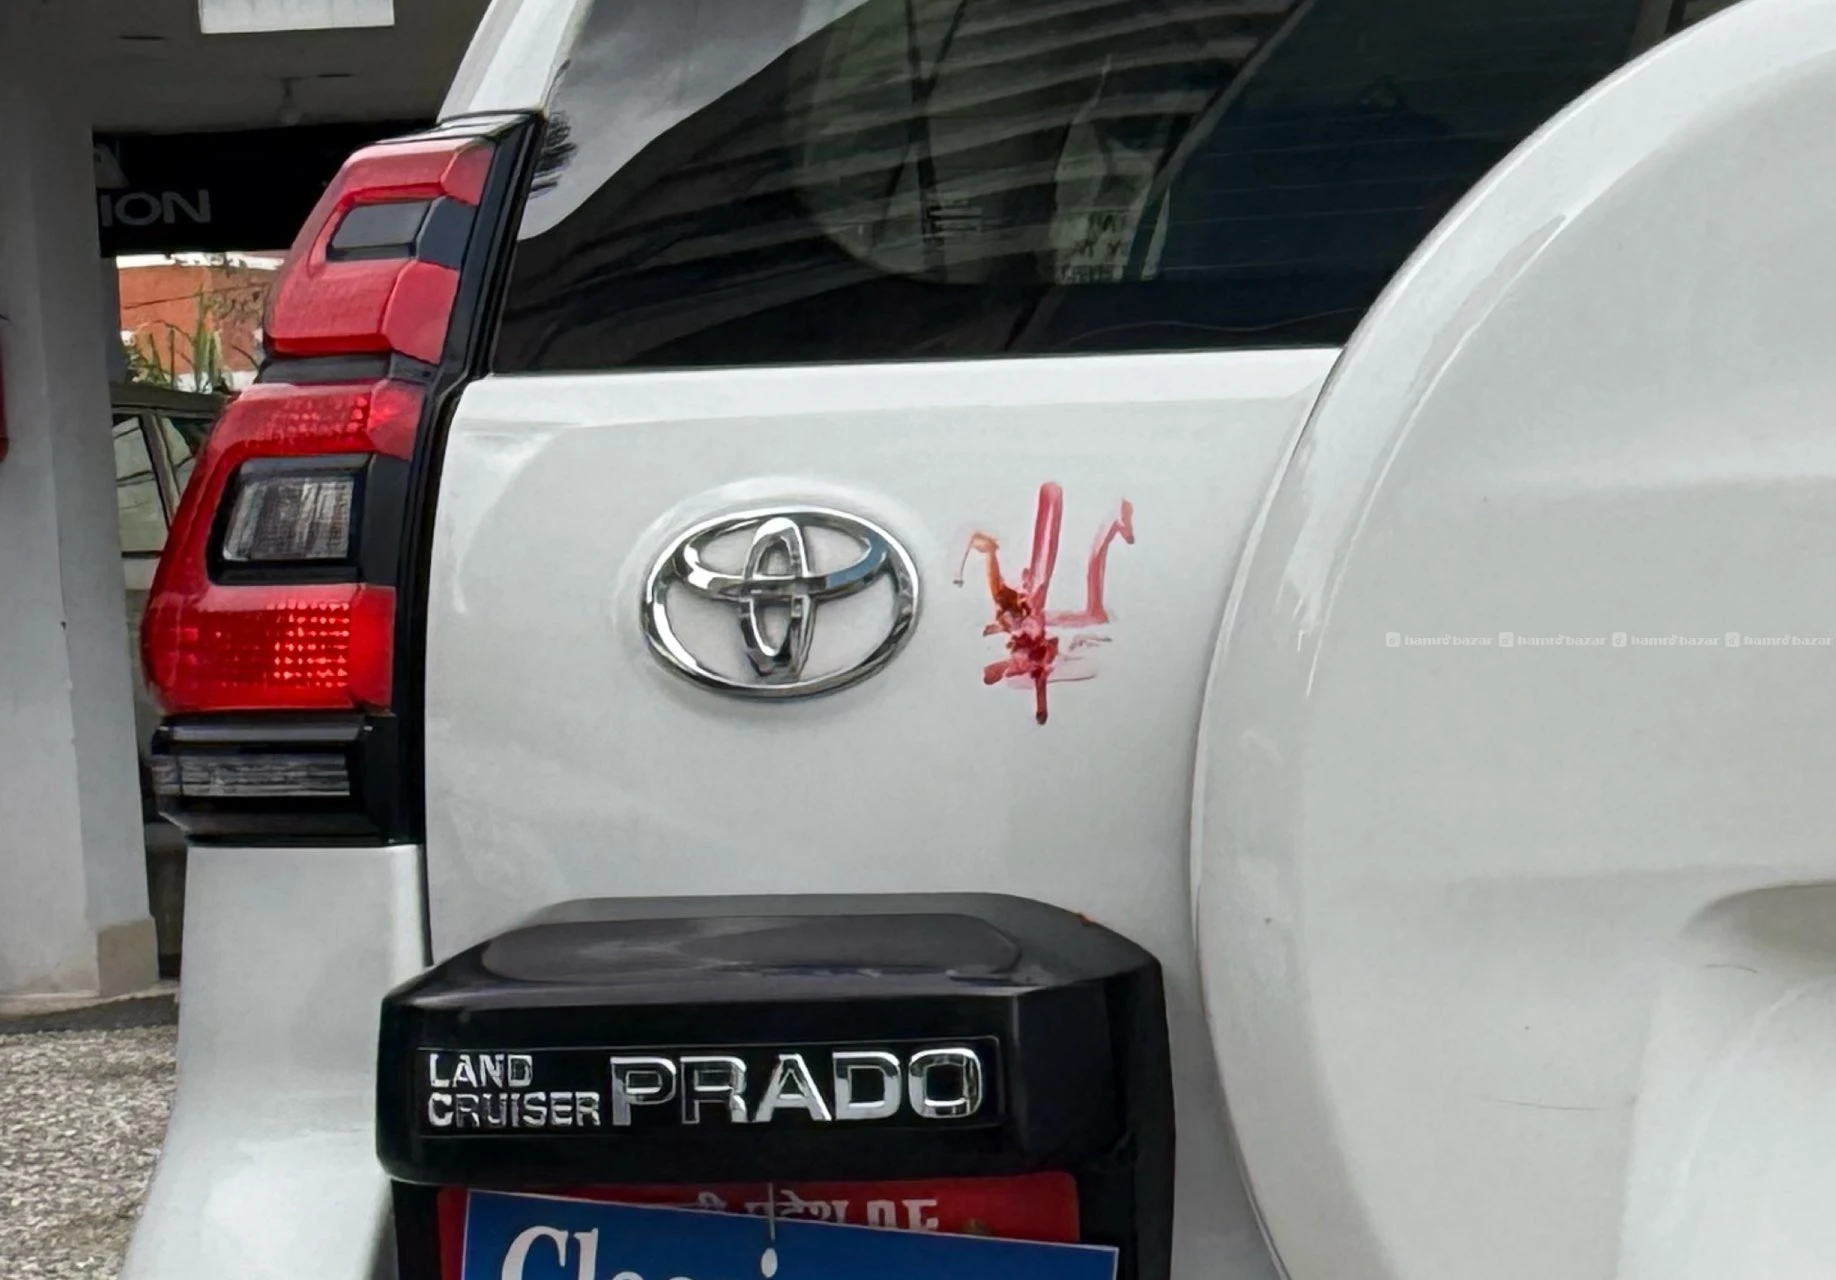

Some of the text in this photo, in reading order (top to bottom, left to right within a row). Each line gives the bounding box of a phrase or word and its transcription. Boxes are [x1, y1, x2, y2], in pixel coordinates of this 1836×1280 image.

[429, 1052, 533, 1088] LAND
[610, 1048, 984, 1127] PRADO
[427, 1091, 601, 1127] CRUISER
